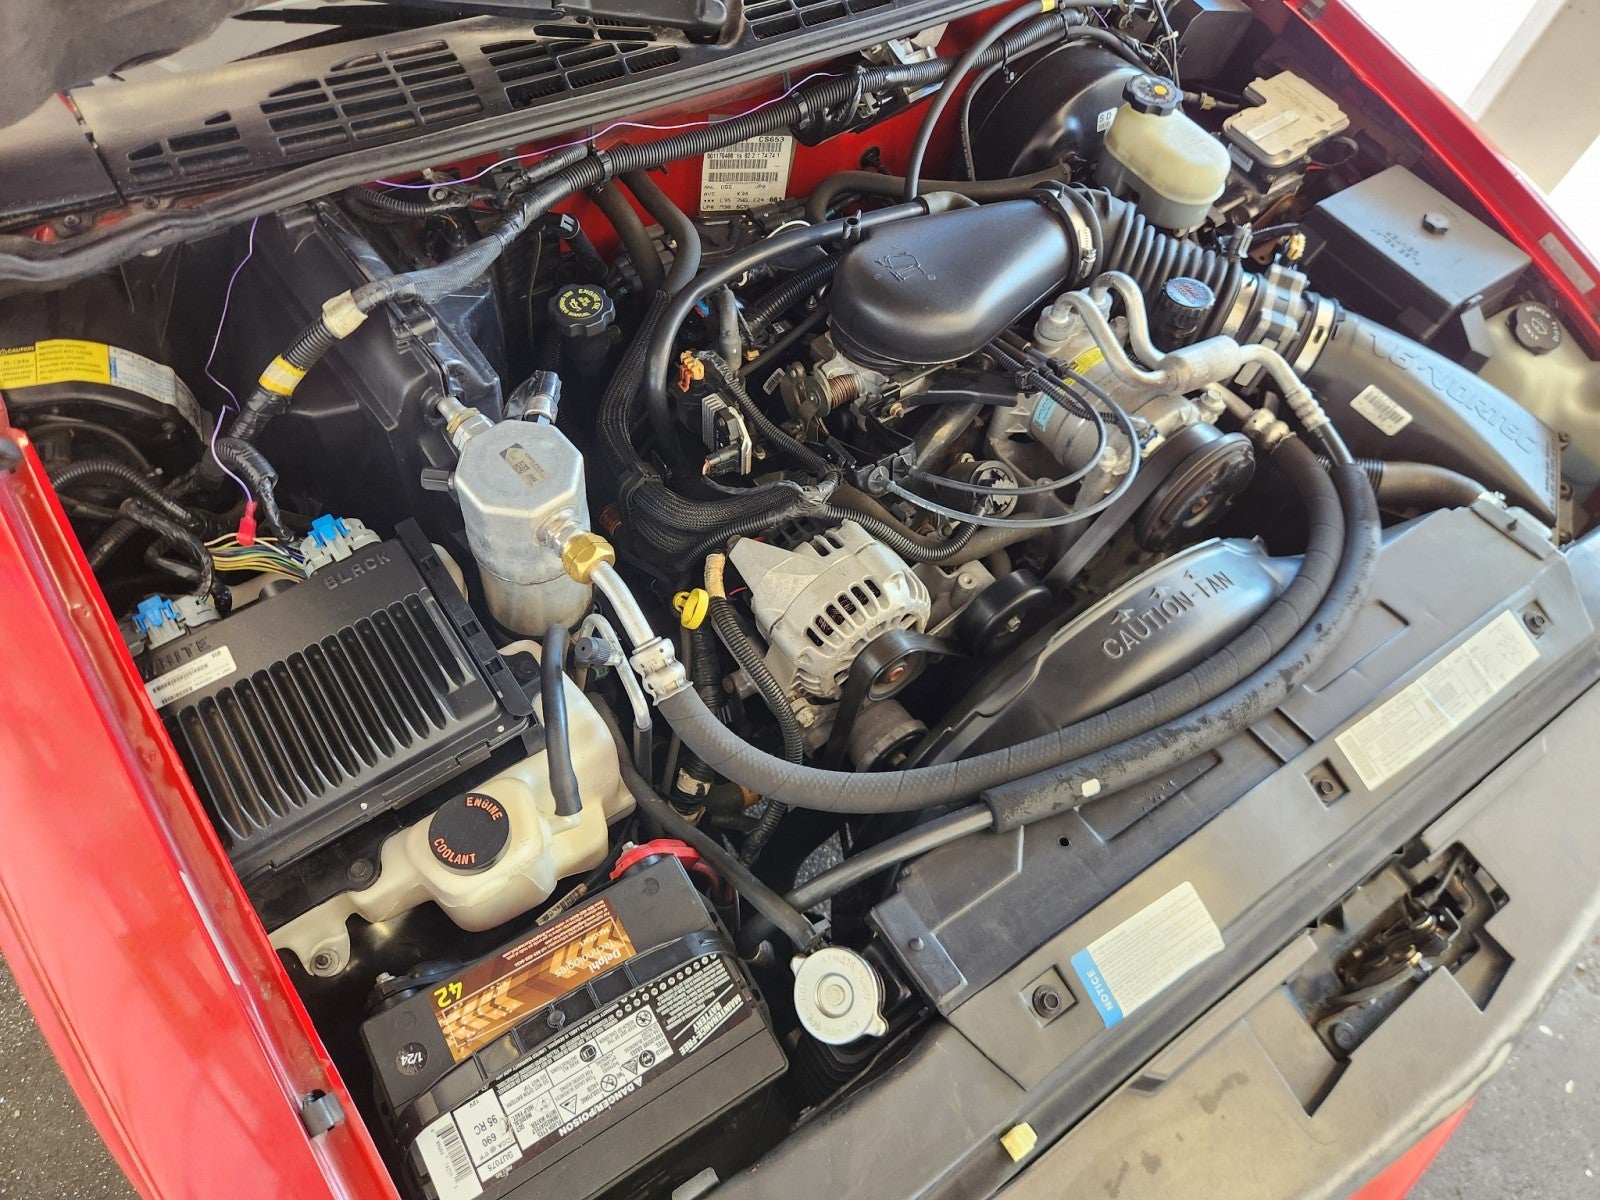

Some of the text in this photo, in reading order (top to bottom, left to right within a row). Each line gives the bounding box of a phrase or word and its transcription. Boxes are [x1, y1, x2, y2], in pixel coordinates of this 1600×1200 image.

[577, 288, 600, 301] ENGINE
[322, 550, 392, 591] BLACK
[465, 794, 504, 822] ENGINE
[432, 836, 478, 866] COOLANT
[551, 938, 615, 978] Technologies
[586, 948, 622, 973] Delphi
[433, 980, 463, 1007] 42
[1084, 967, 1115, 1012] NOTICE
[678, 993, 741, 1056] MAINTENANCE-FREE
[691, 1001, 722, 1032] BATTERY
[399, 1051, 423, 1066] 1/24
[467, 1098, 479, 1108] 12V
[557, 1081, 634, 1136] DANGER/POISON
[472, 1114, 498, 1135] 95 RC
[480, 1132, 498, 1147] 690
